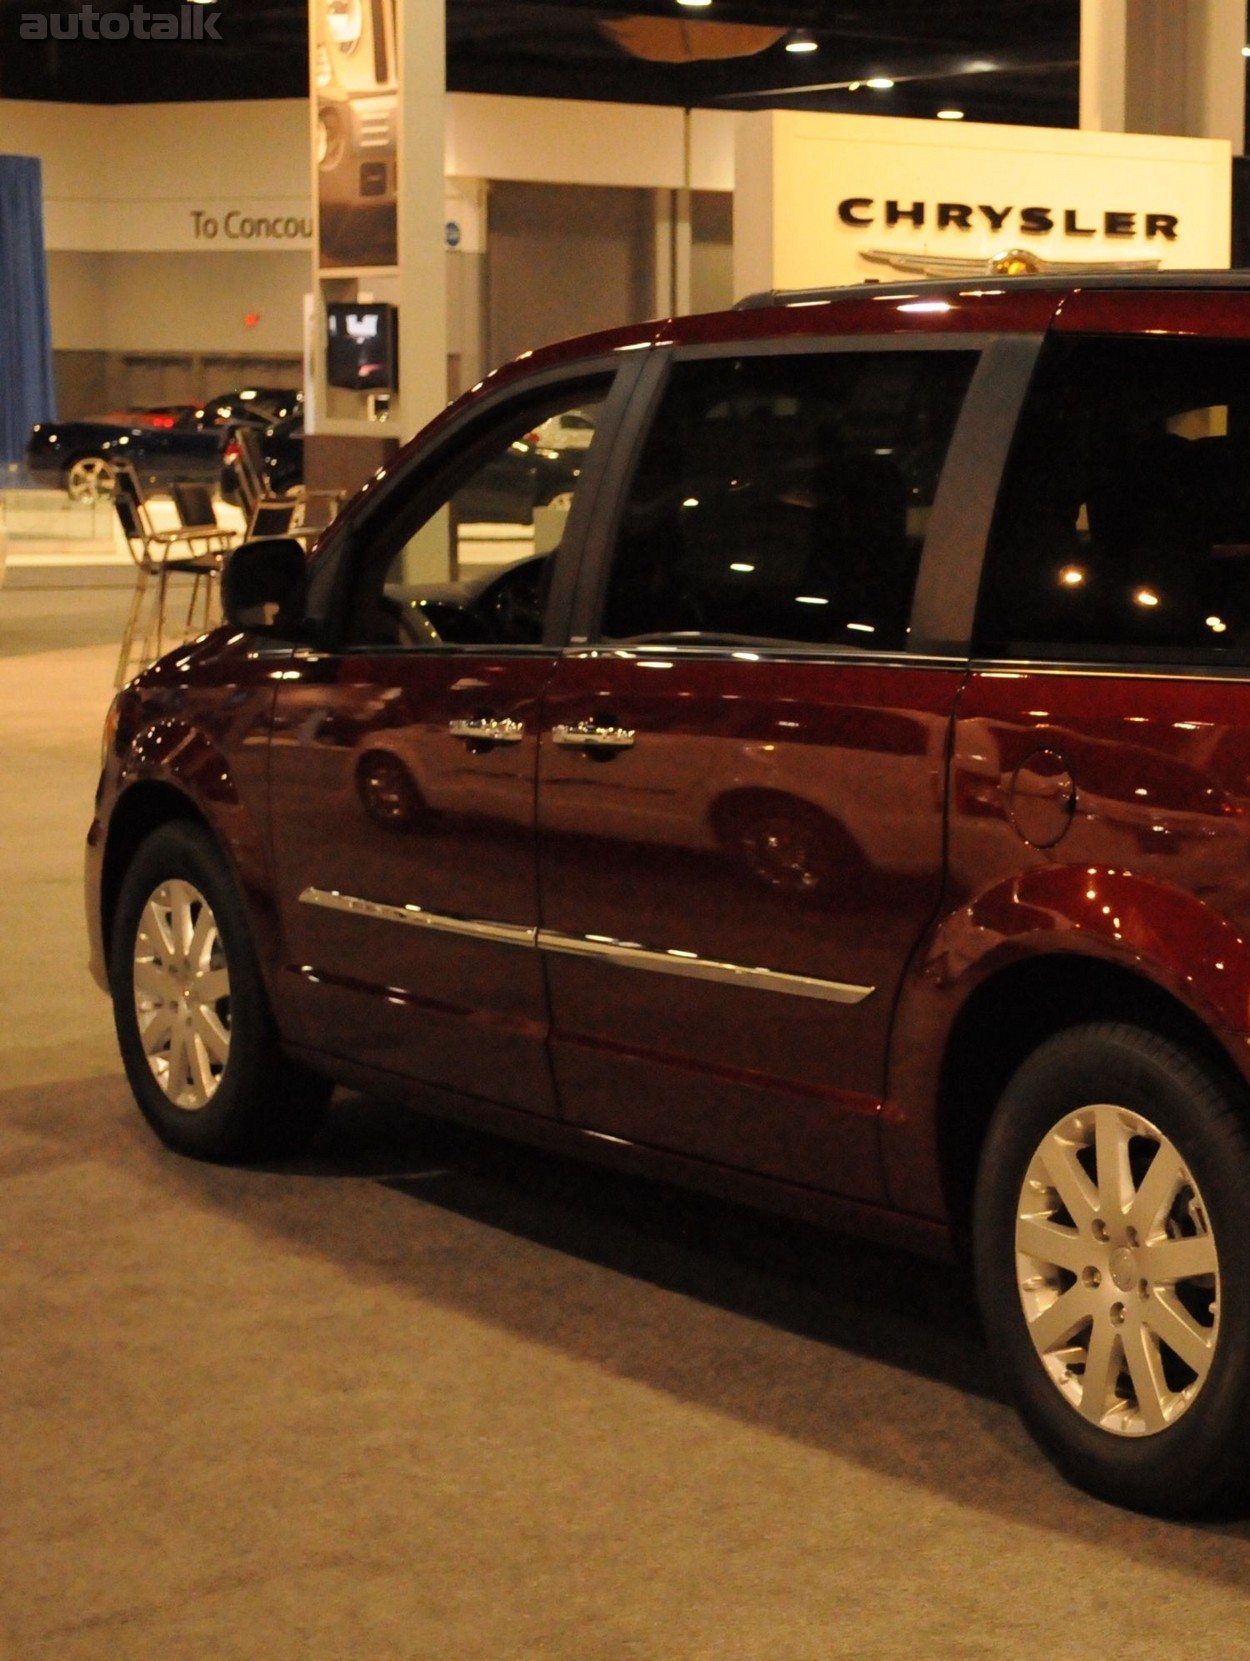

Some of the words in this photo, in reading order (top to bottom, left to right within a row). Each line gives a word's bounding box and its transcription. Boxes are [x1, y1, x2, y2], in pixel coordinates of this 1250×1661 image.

[190, 210, 218, 239] To
[224, 210, 312, 239] Concou
[838, 198, 1179, 239] CHRYSLER
